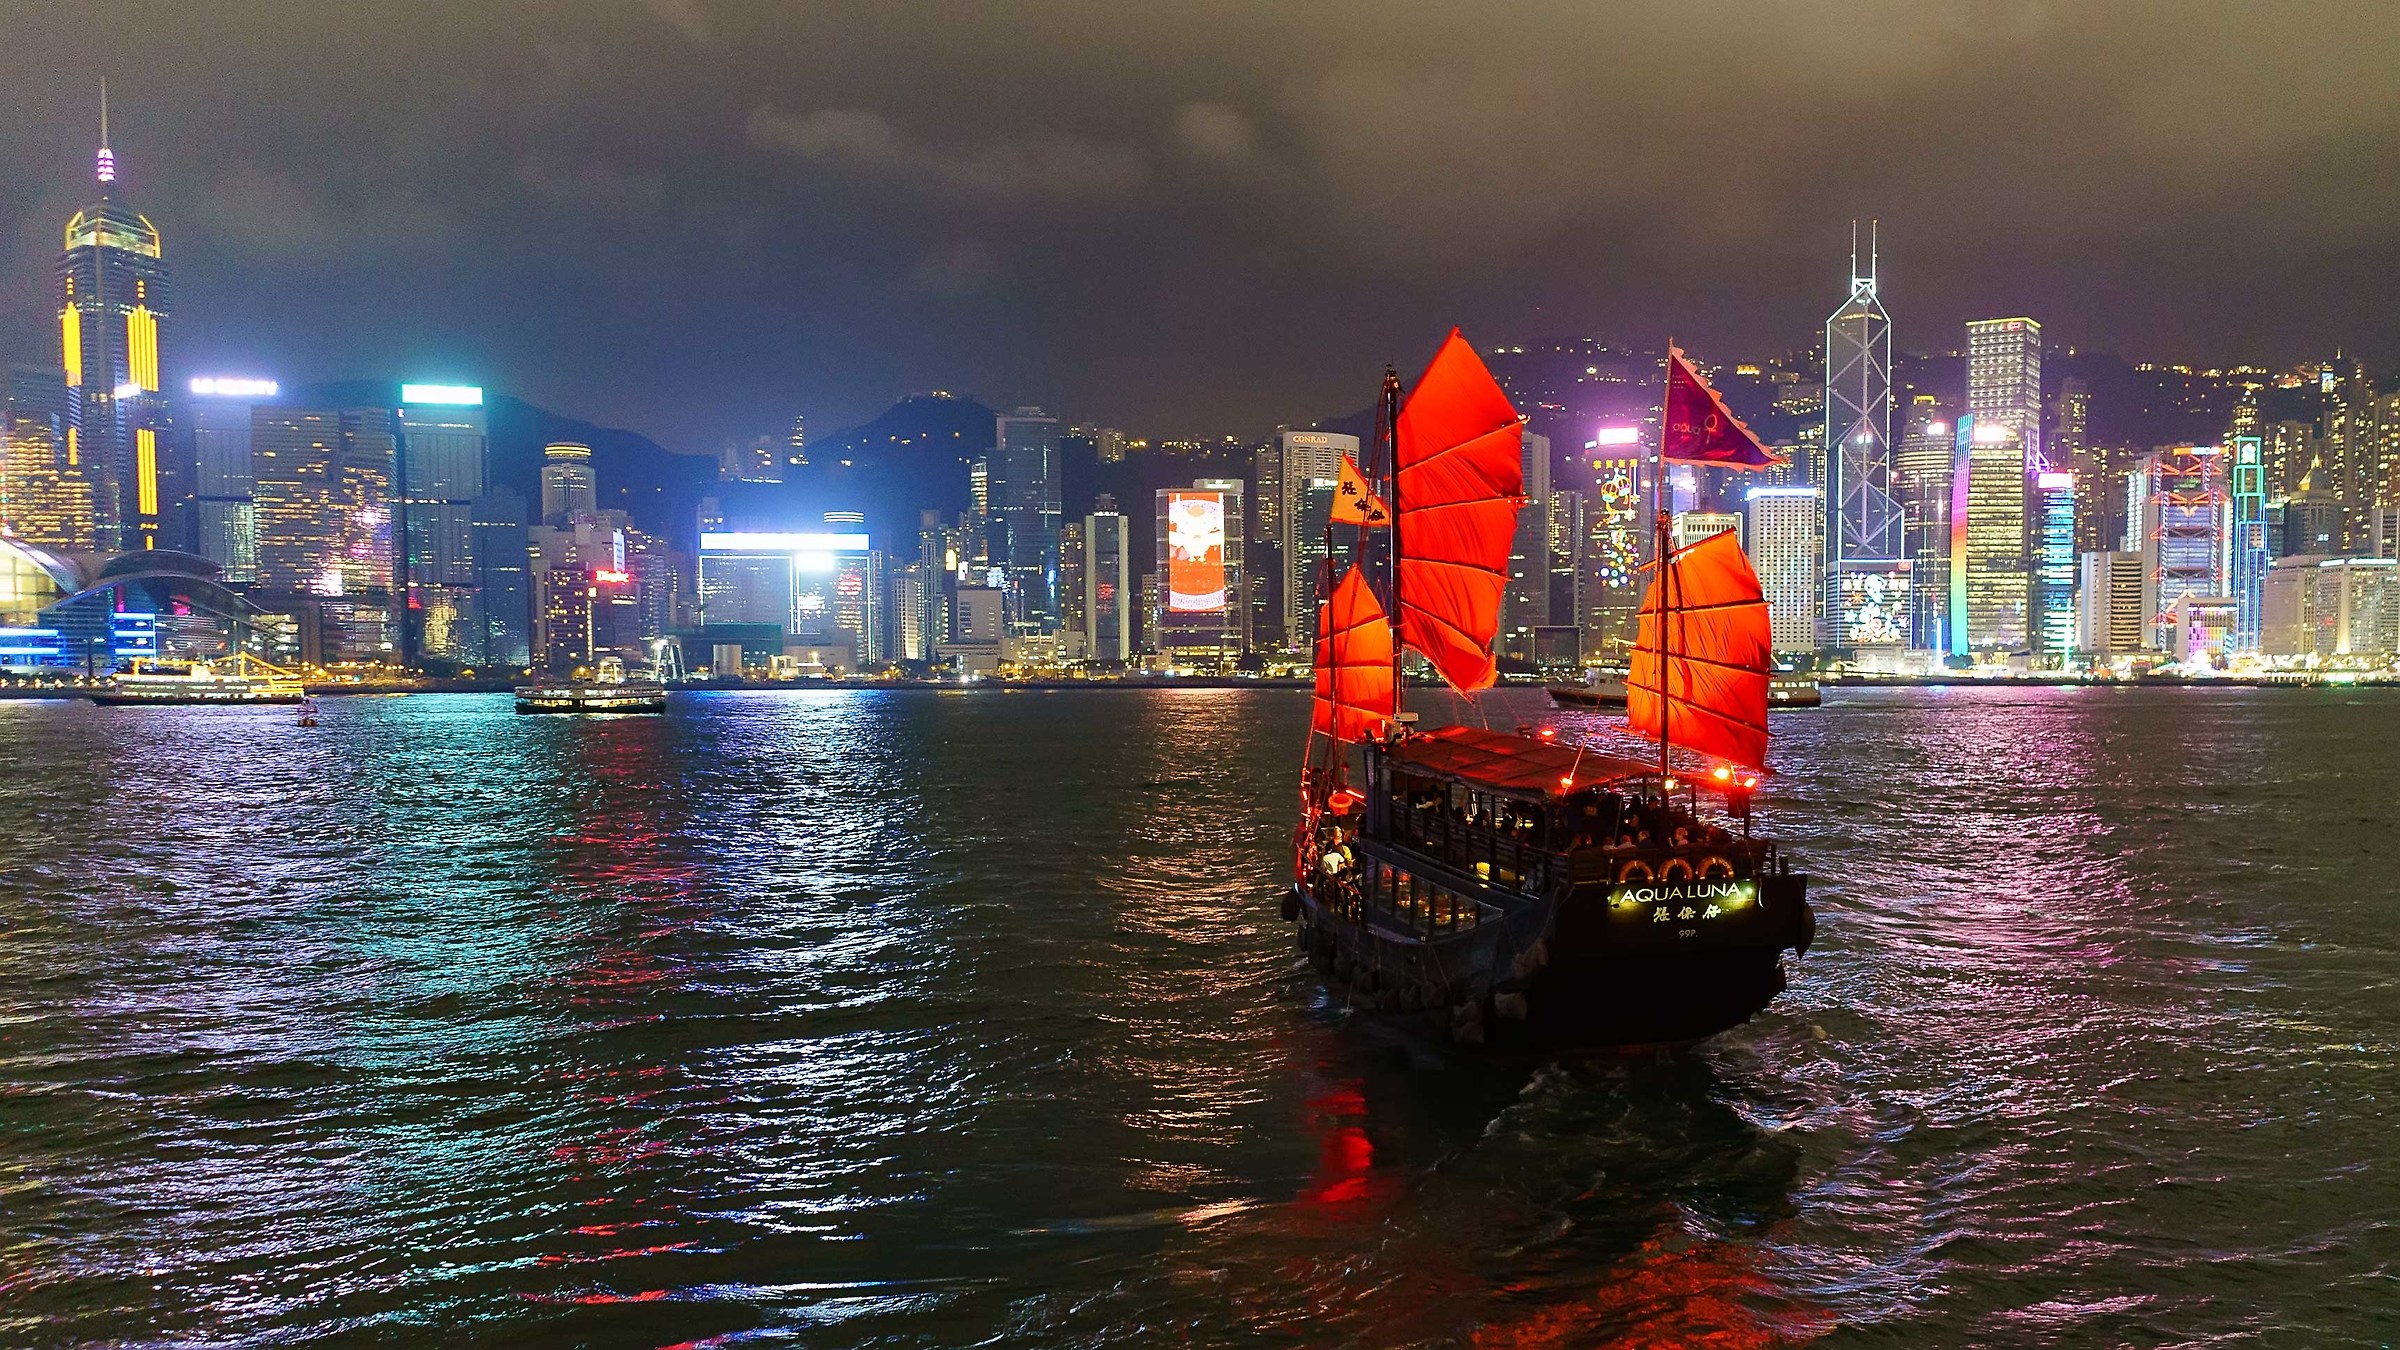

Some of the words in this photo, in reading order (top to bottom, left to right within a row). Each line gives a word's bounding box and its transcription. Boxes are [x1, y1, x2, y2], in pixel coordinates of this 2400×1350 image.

[1292, 435, 1328, 444] CONRAD
[1620, 887, 1683, 903] AQUA
[1687, 882, 1741, 899] LUNA
